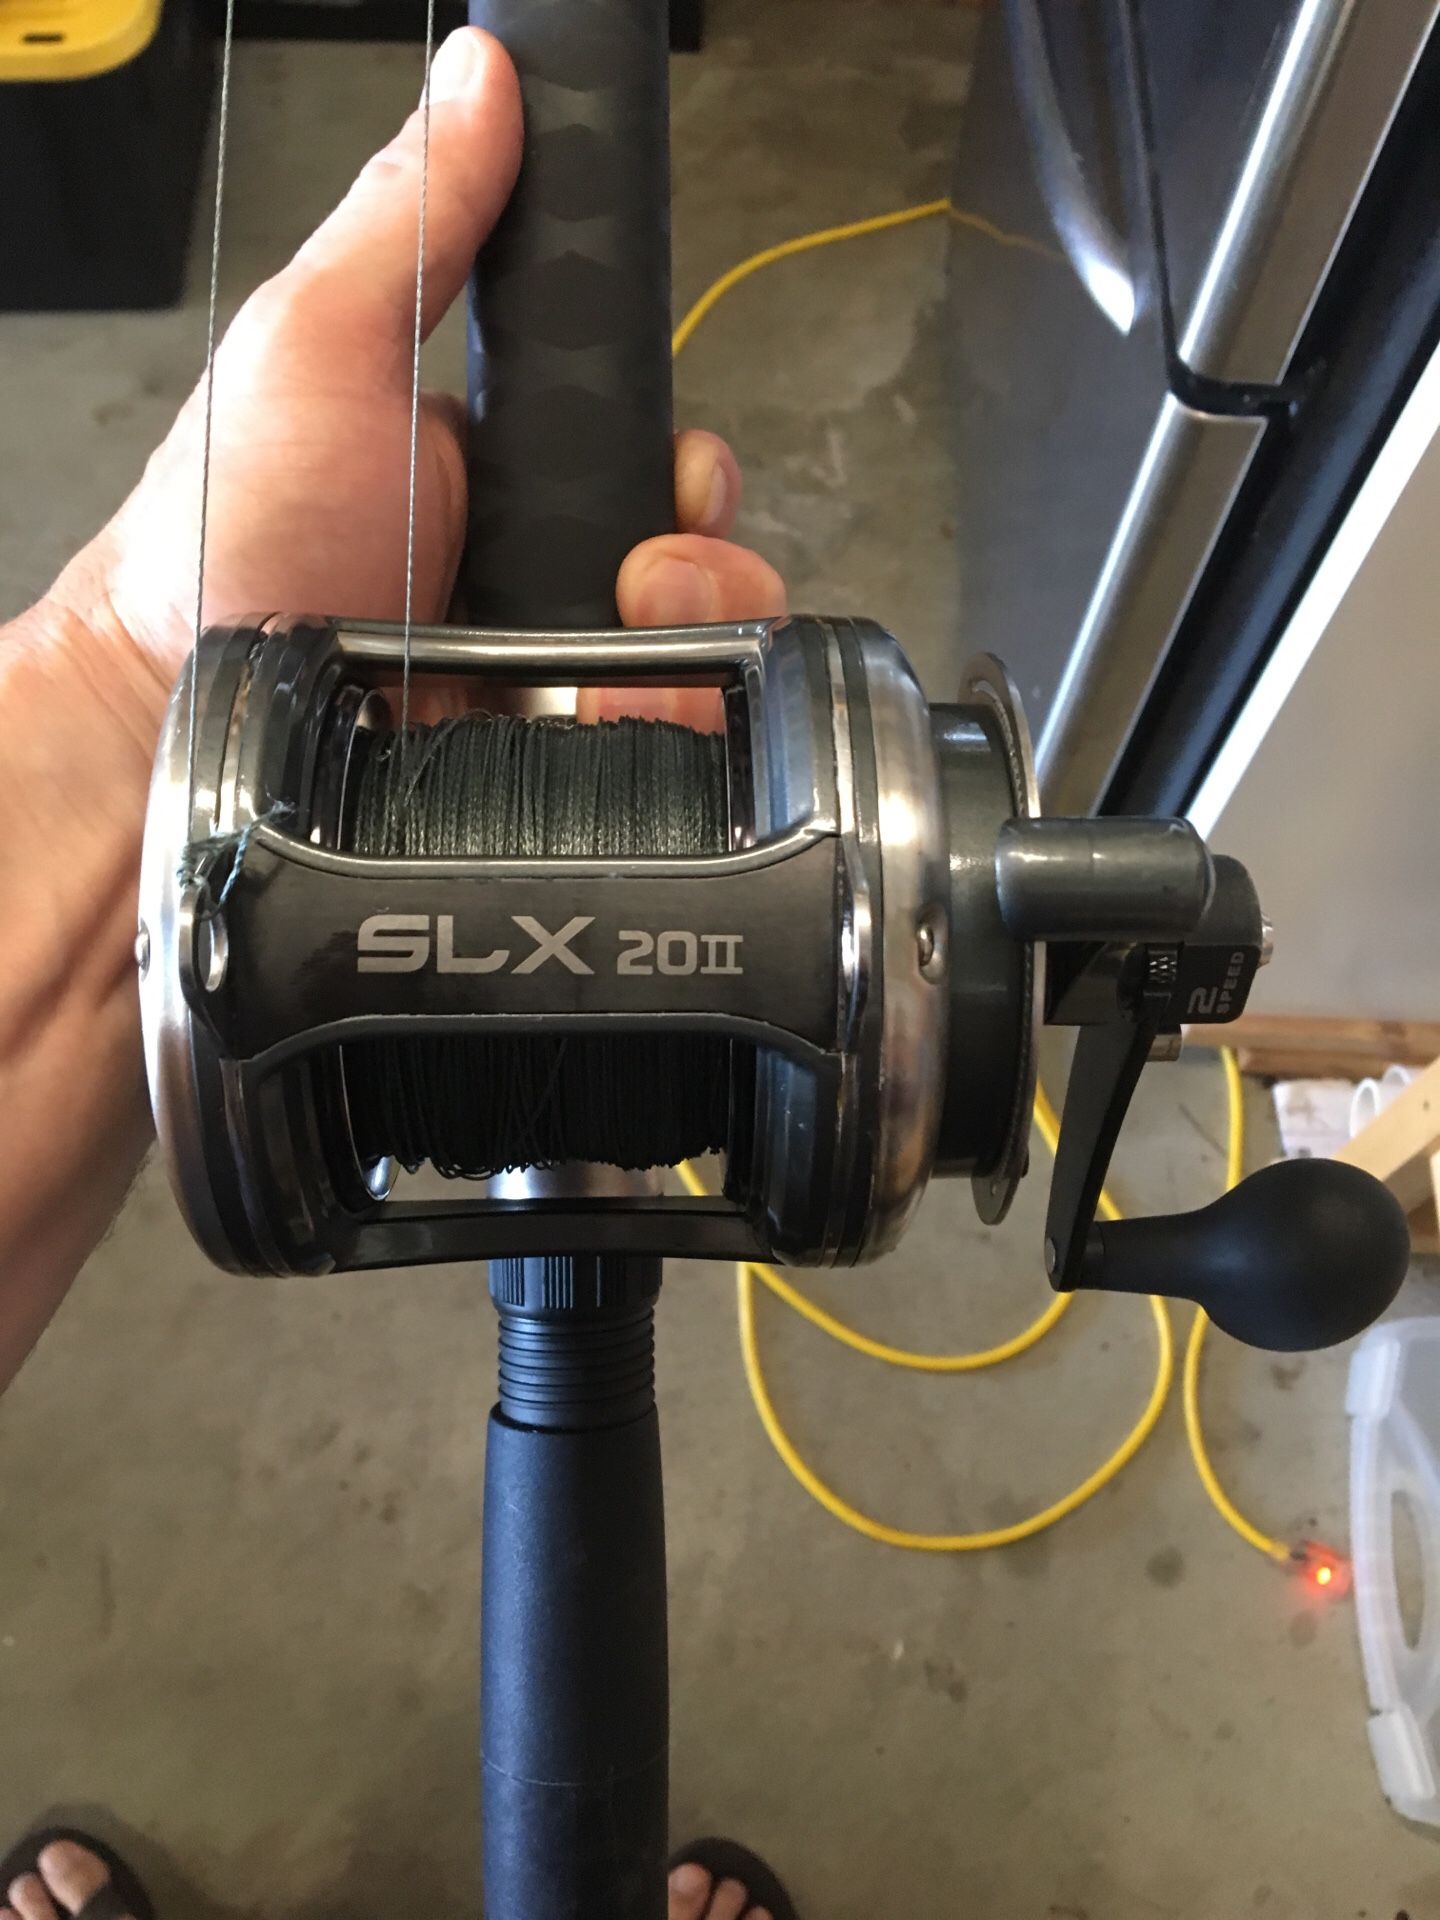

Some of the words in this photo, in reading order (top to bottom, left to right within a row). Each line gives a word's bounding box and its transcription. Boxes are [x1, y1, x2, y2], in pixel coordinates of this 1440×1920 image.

[357, 914, 596, 975] SLX
[1187, 987, 1219, 1015] 2
[1216, 951, 1245, 1014] SPEED
